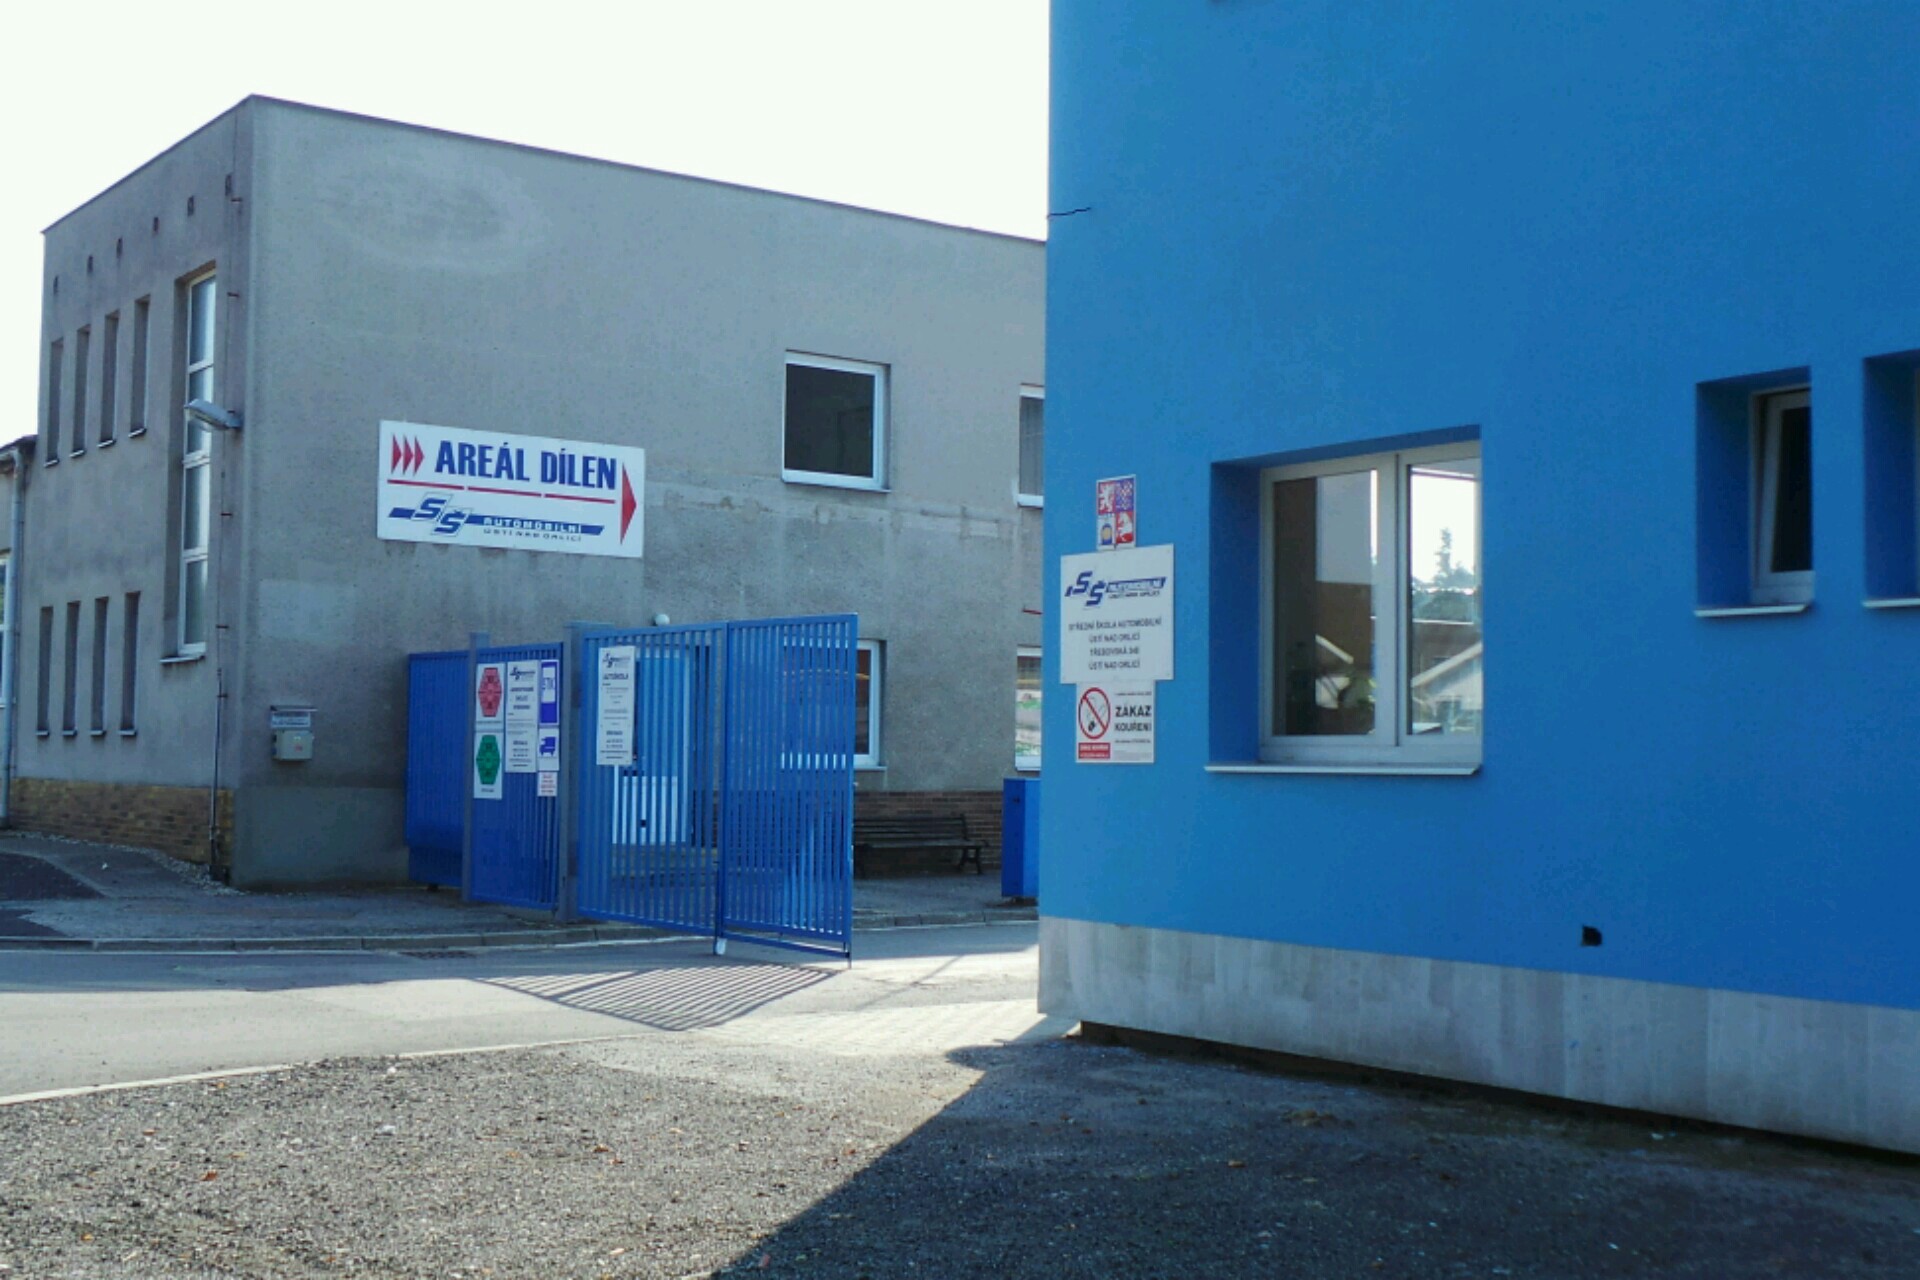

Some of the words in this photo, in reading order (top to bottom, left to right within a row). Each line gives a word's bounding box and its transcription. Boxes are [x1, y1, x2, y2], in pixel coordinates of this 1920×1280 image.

[434, 441, 531, 482] AREÁL
[540, 447, 617, 490] DÍLEN
[483, 516, 581, 534] AUTOMOBILNÍ
[1115, 702, 1152, 718] ZÁKAZ
